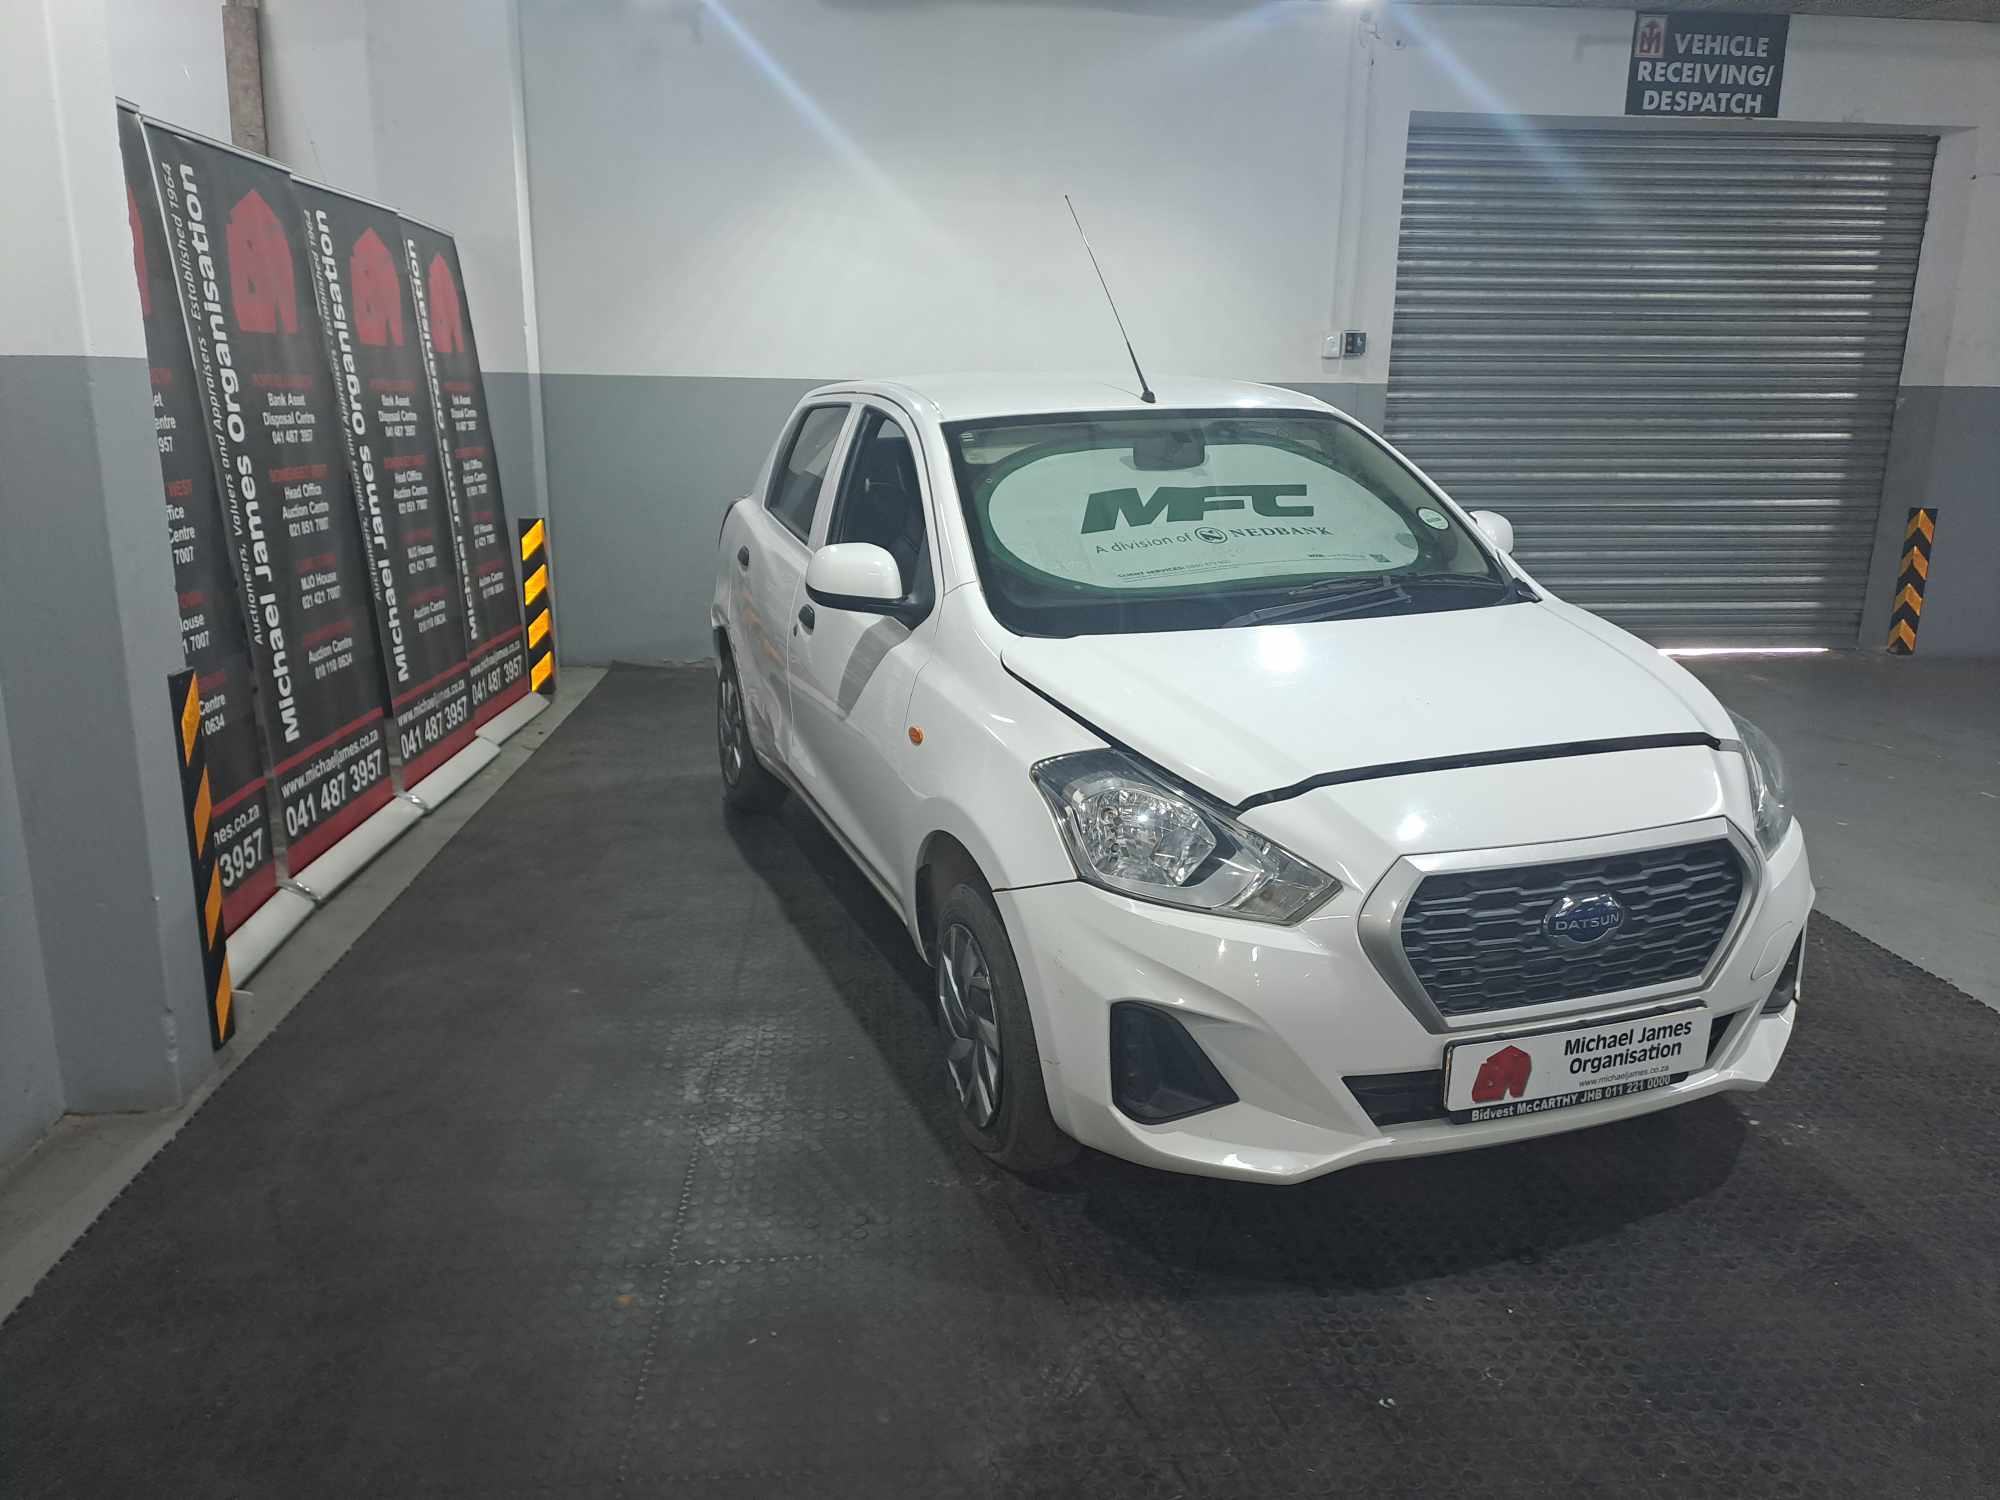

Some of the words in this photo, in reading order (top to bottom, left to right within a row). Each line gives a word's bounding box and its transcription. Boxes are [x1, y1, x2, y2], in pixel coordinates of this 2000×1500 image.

[1674, 33, 1769, 57] VEHICLE
[1637, 61, 1775, 87] RECEIVING/
[1642, 89, 1762, 114] DESPATCH
[161, 162, 179, 209] 1964
[171, 213, 201, 321] Established
[180, 163, 245, 443] Organisation
[315, 209, 366, 436] Organisation
[199, 337, 224, 431] Appraisers
[158, 435, 173, 453] 957
[215, 434, 231, 469] and
[225, 473, 243, 536] Valuers
[236, 455, 273, 582] James
[359, 445, 388, 550] James
[1080, 484, 1315, 535] MFC
[1095, 544, 1109, 555] A
[1111, 536, 1173, 554] division
[1176, 532, 1193, 544] of
[1230, 526, 1334, 538] NEDBANK
[190, 630, 209, 651] 7007
[377, 559, 409, 682] Michael
[259, 593, 300, 743] Michael
[471, 684, 487, 705] 041
[487, 667, 501, 693] 487
[503, 654, 521, 683] 3957
[205, 713, 225, 736] 0634
[400, 725, 423, 759] 041
[424, 712, 442, 742] 487
[444, 695, 468, 730] 3957
[281, 729, 379, 799] www.michaeljames.co.za
[285, 792, 317, 837] 041
[320, 772, 347, 811] 487
[350, 749, 382, 793] 3957
[219, 828, 263, 887] 3957
[1555, 911, 1619, 931] DATSUN
[1564, 1028, 1634, 1056] Michael
[1637, 1021, 1693, 1044] James
[1569, 1041, 1682, 1074] Organisation
[1579, 1065, 1669, 1087] www.michaeljames.co.za
[1471, 1105, 1513, 1122] Bidvest
[1516, 1092, 1580, 1115] McCARTHY
[1580, 1090, 1602, 1103] JHB
[1604, 1085, 1623, 1098] 011
[1625, 1082, 1644, 1094] 221
